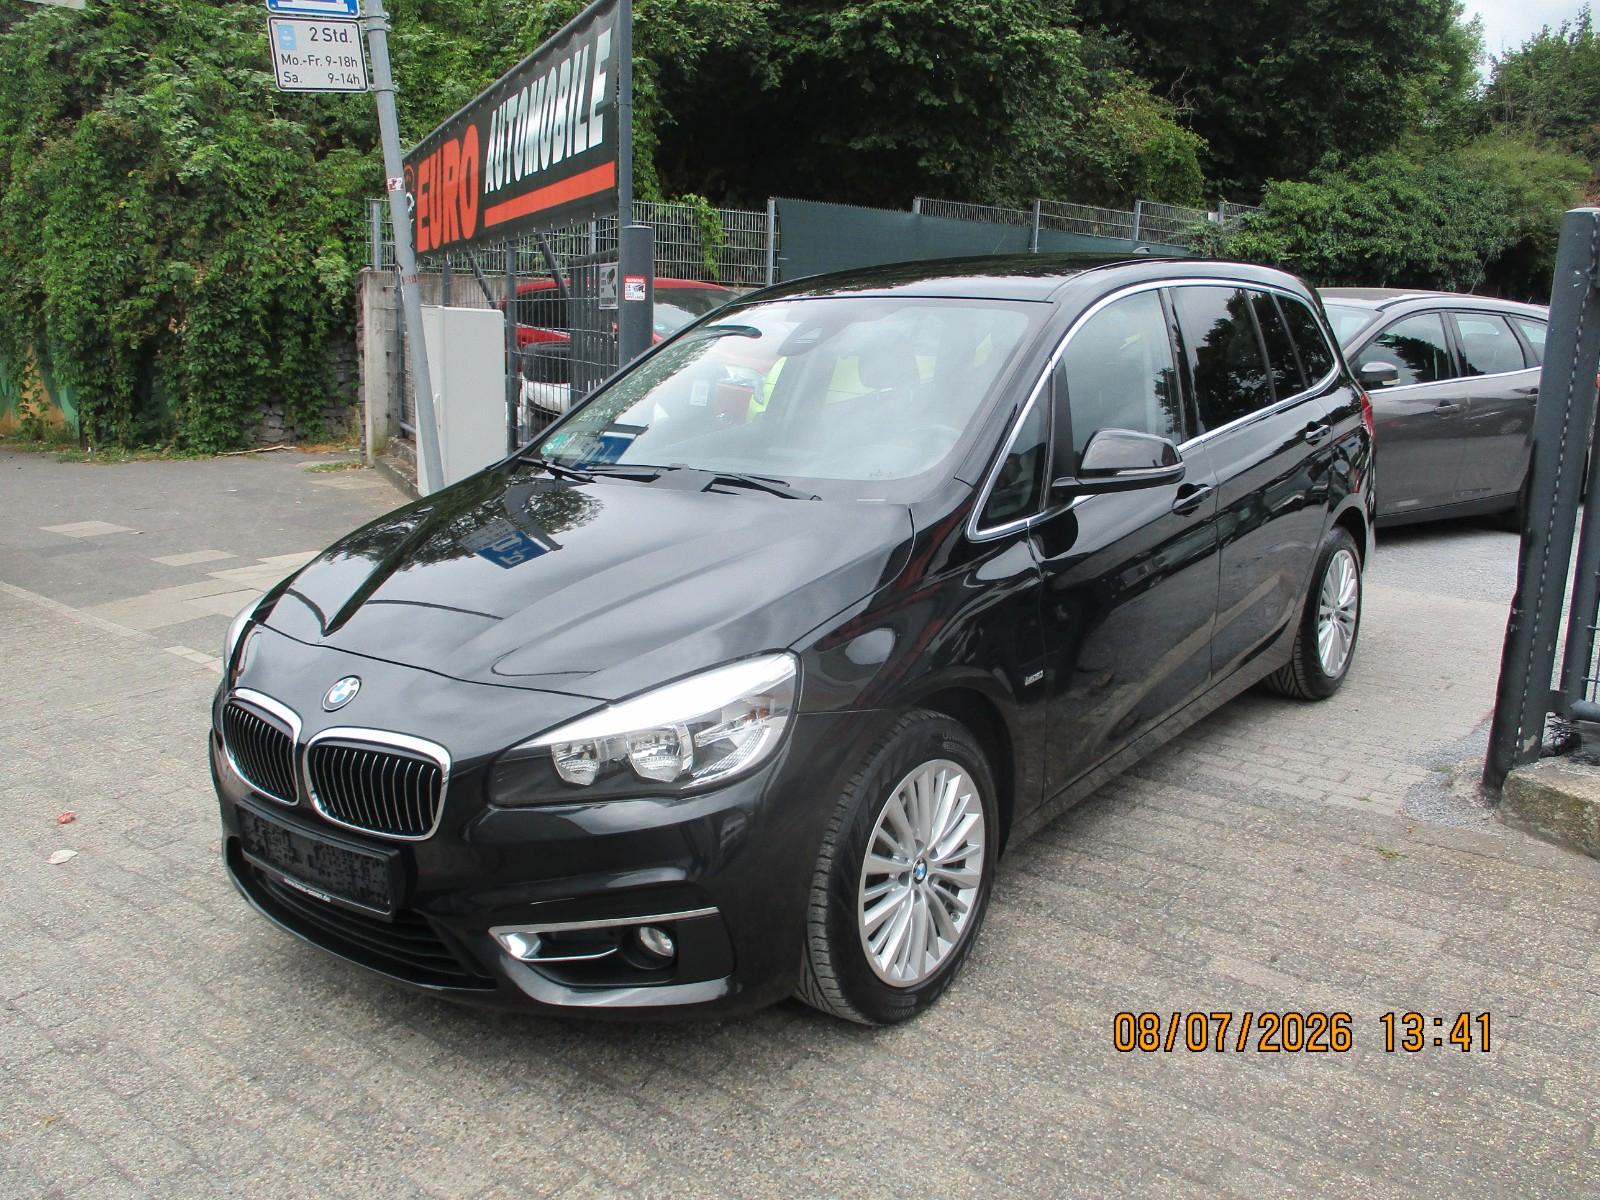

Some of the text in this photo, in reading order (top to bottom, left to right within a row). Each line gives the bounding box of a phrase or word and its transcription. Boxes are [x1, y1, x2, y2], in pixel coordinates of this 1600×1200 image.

[309, 26, 352, 43] 2 Std.
[281, 53, 358, 68] Mo.-Fr. 9-18h
[283, 71, 360, 85] Sa. 9-14h
[416, 27, 612, 253] EURO AUTOMOBILE
